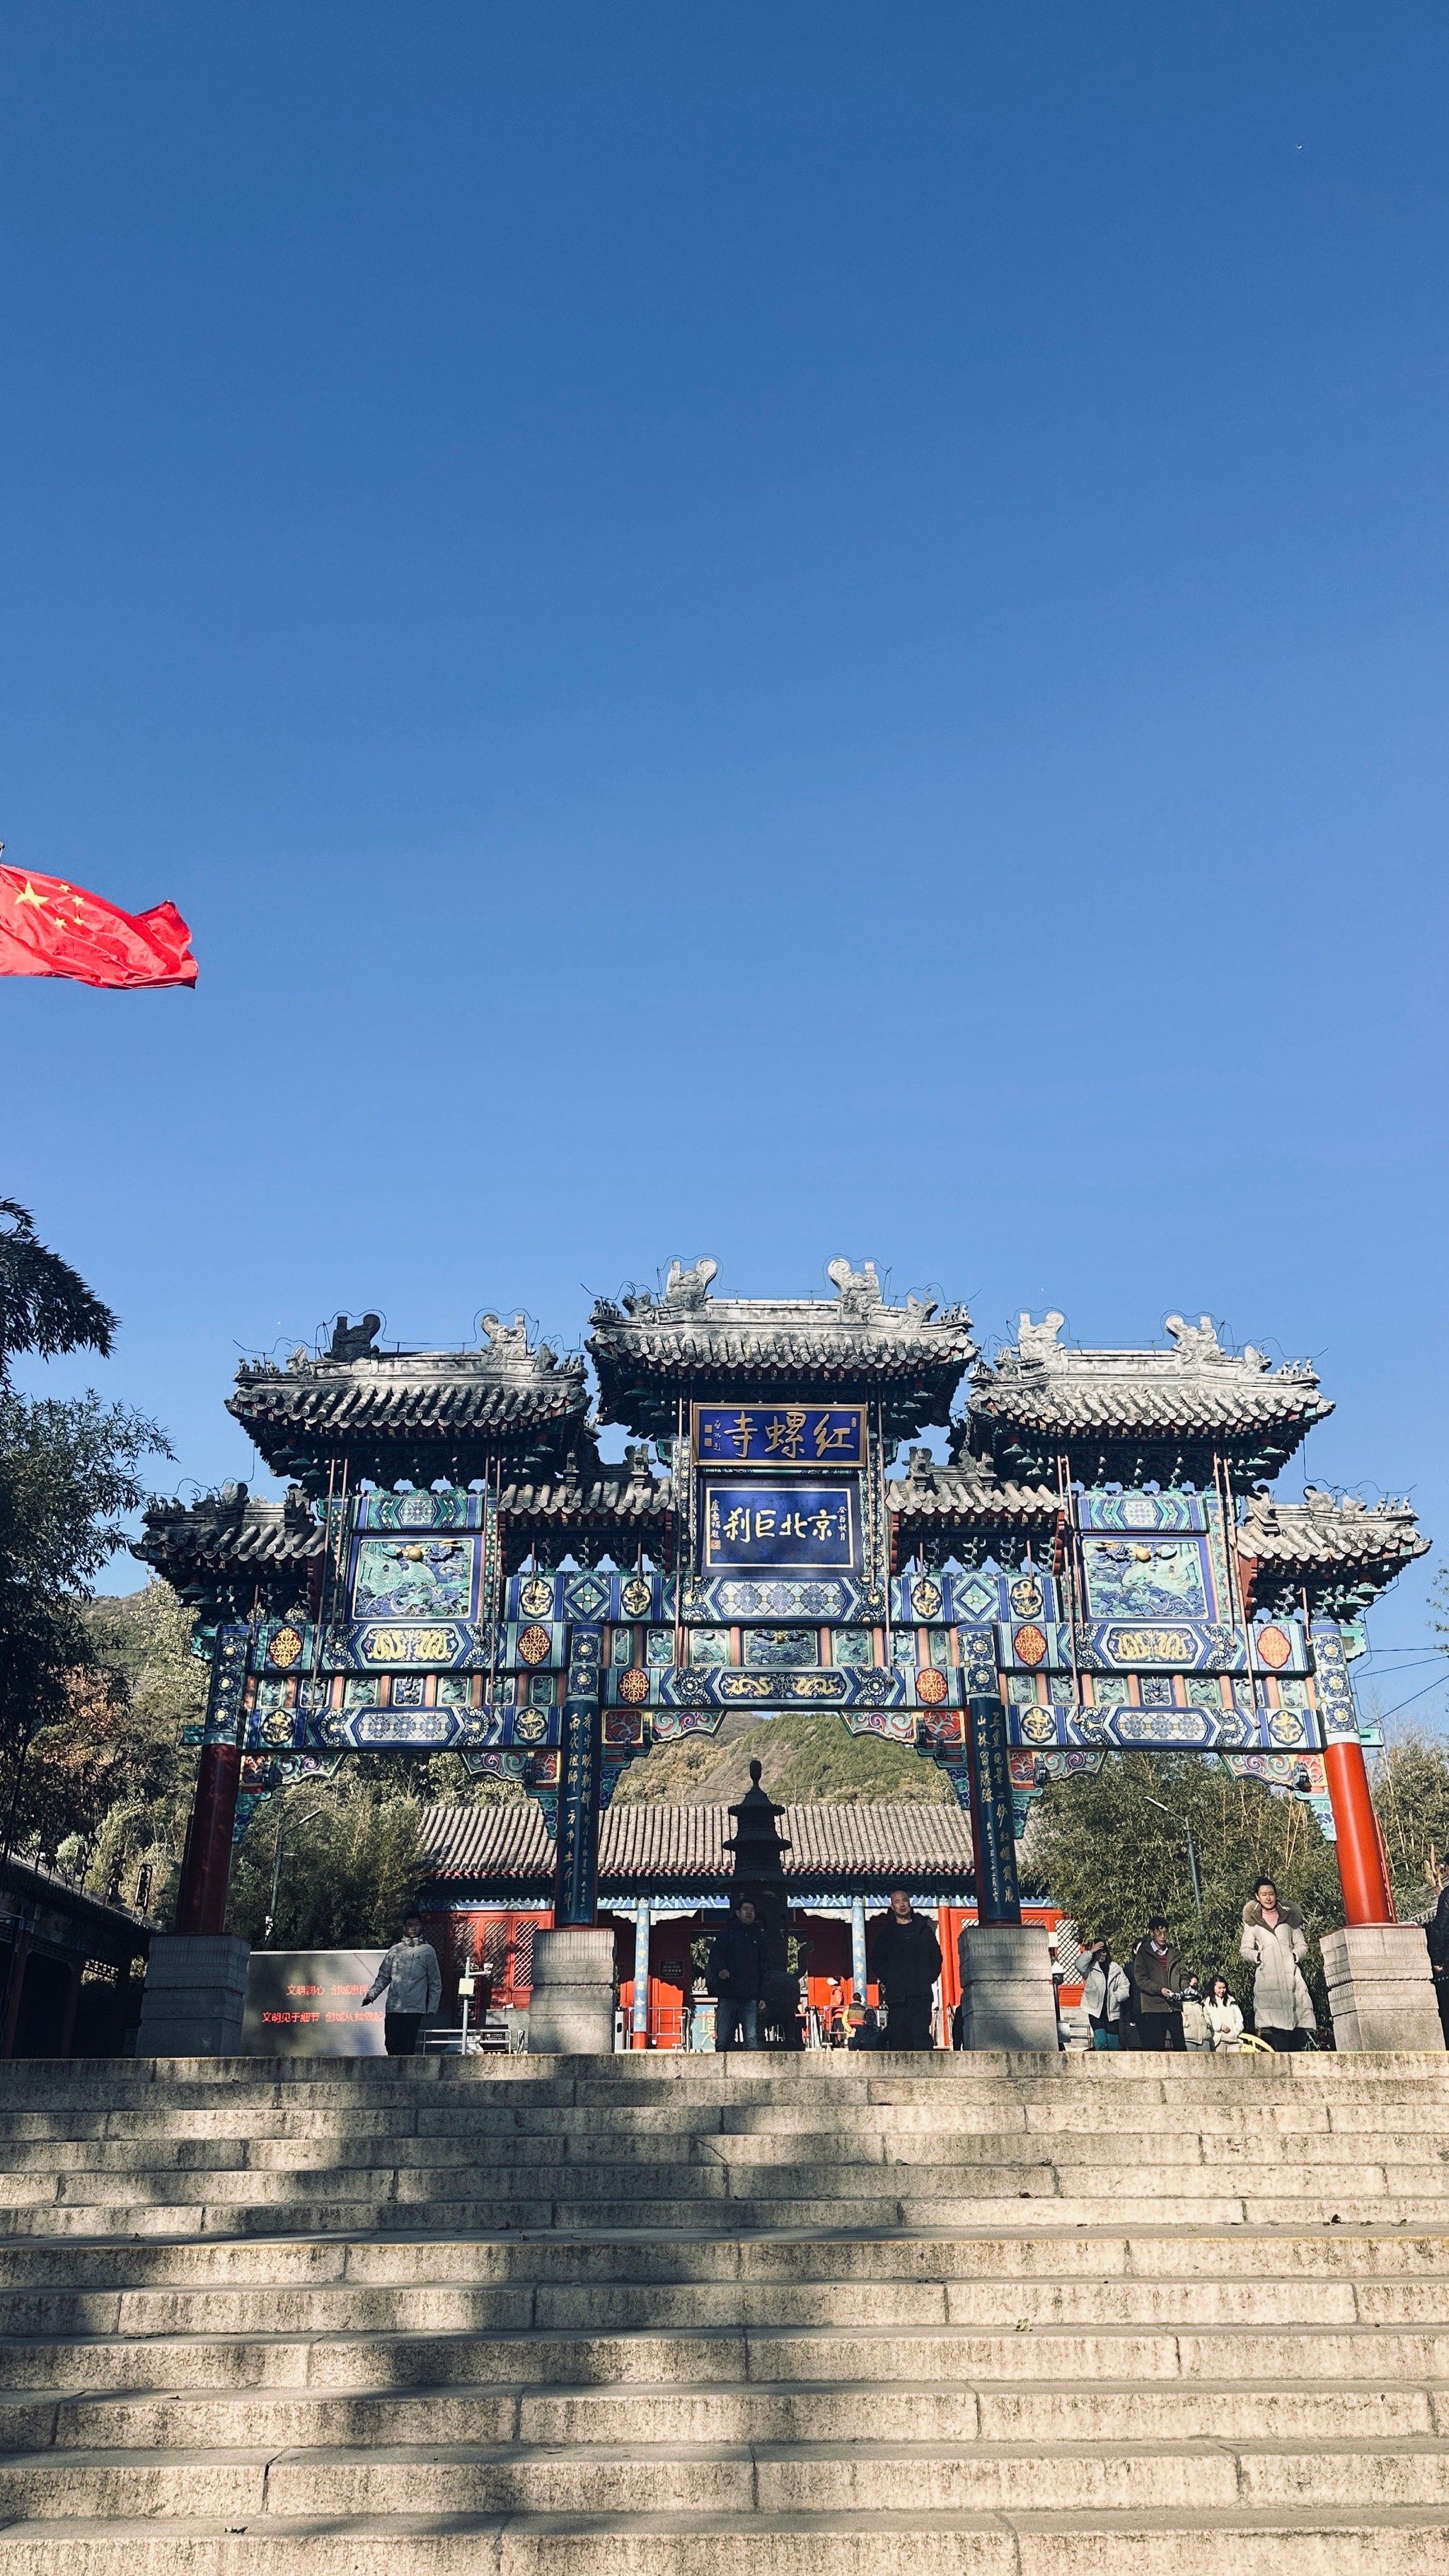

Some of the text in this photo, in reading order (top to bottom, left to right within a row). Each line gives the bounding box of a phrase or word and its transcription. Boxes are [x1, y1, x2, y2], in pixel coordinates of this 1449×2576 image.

[724, 1410, 855, 1459] 红螺寺
[722, 1507, 838, 1543] 京北巨刹
[261, 2011, 321, 2023] 文明见于细节
